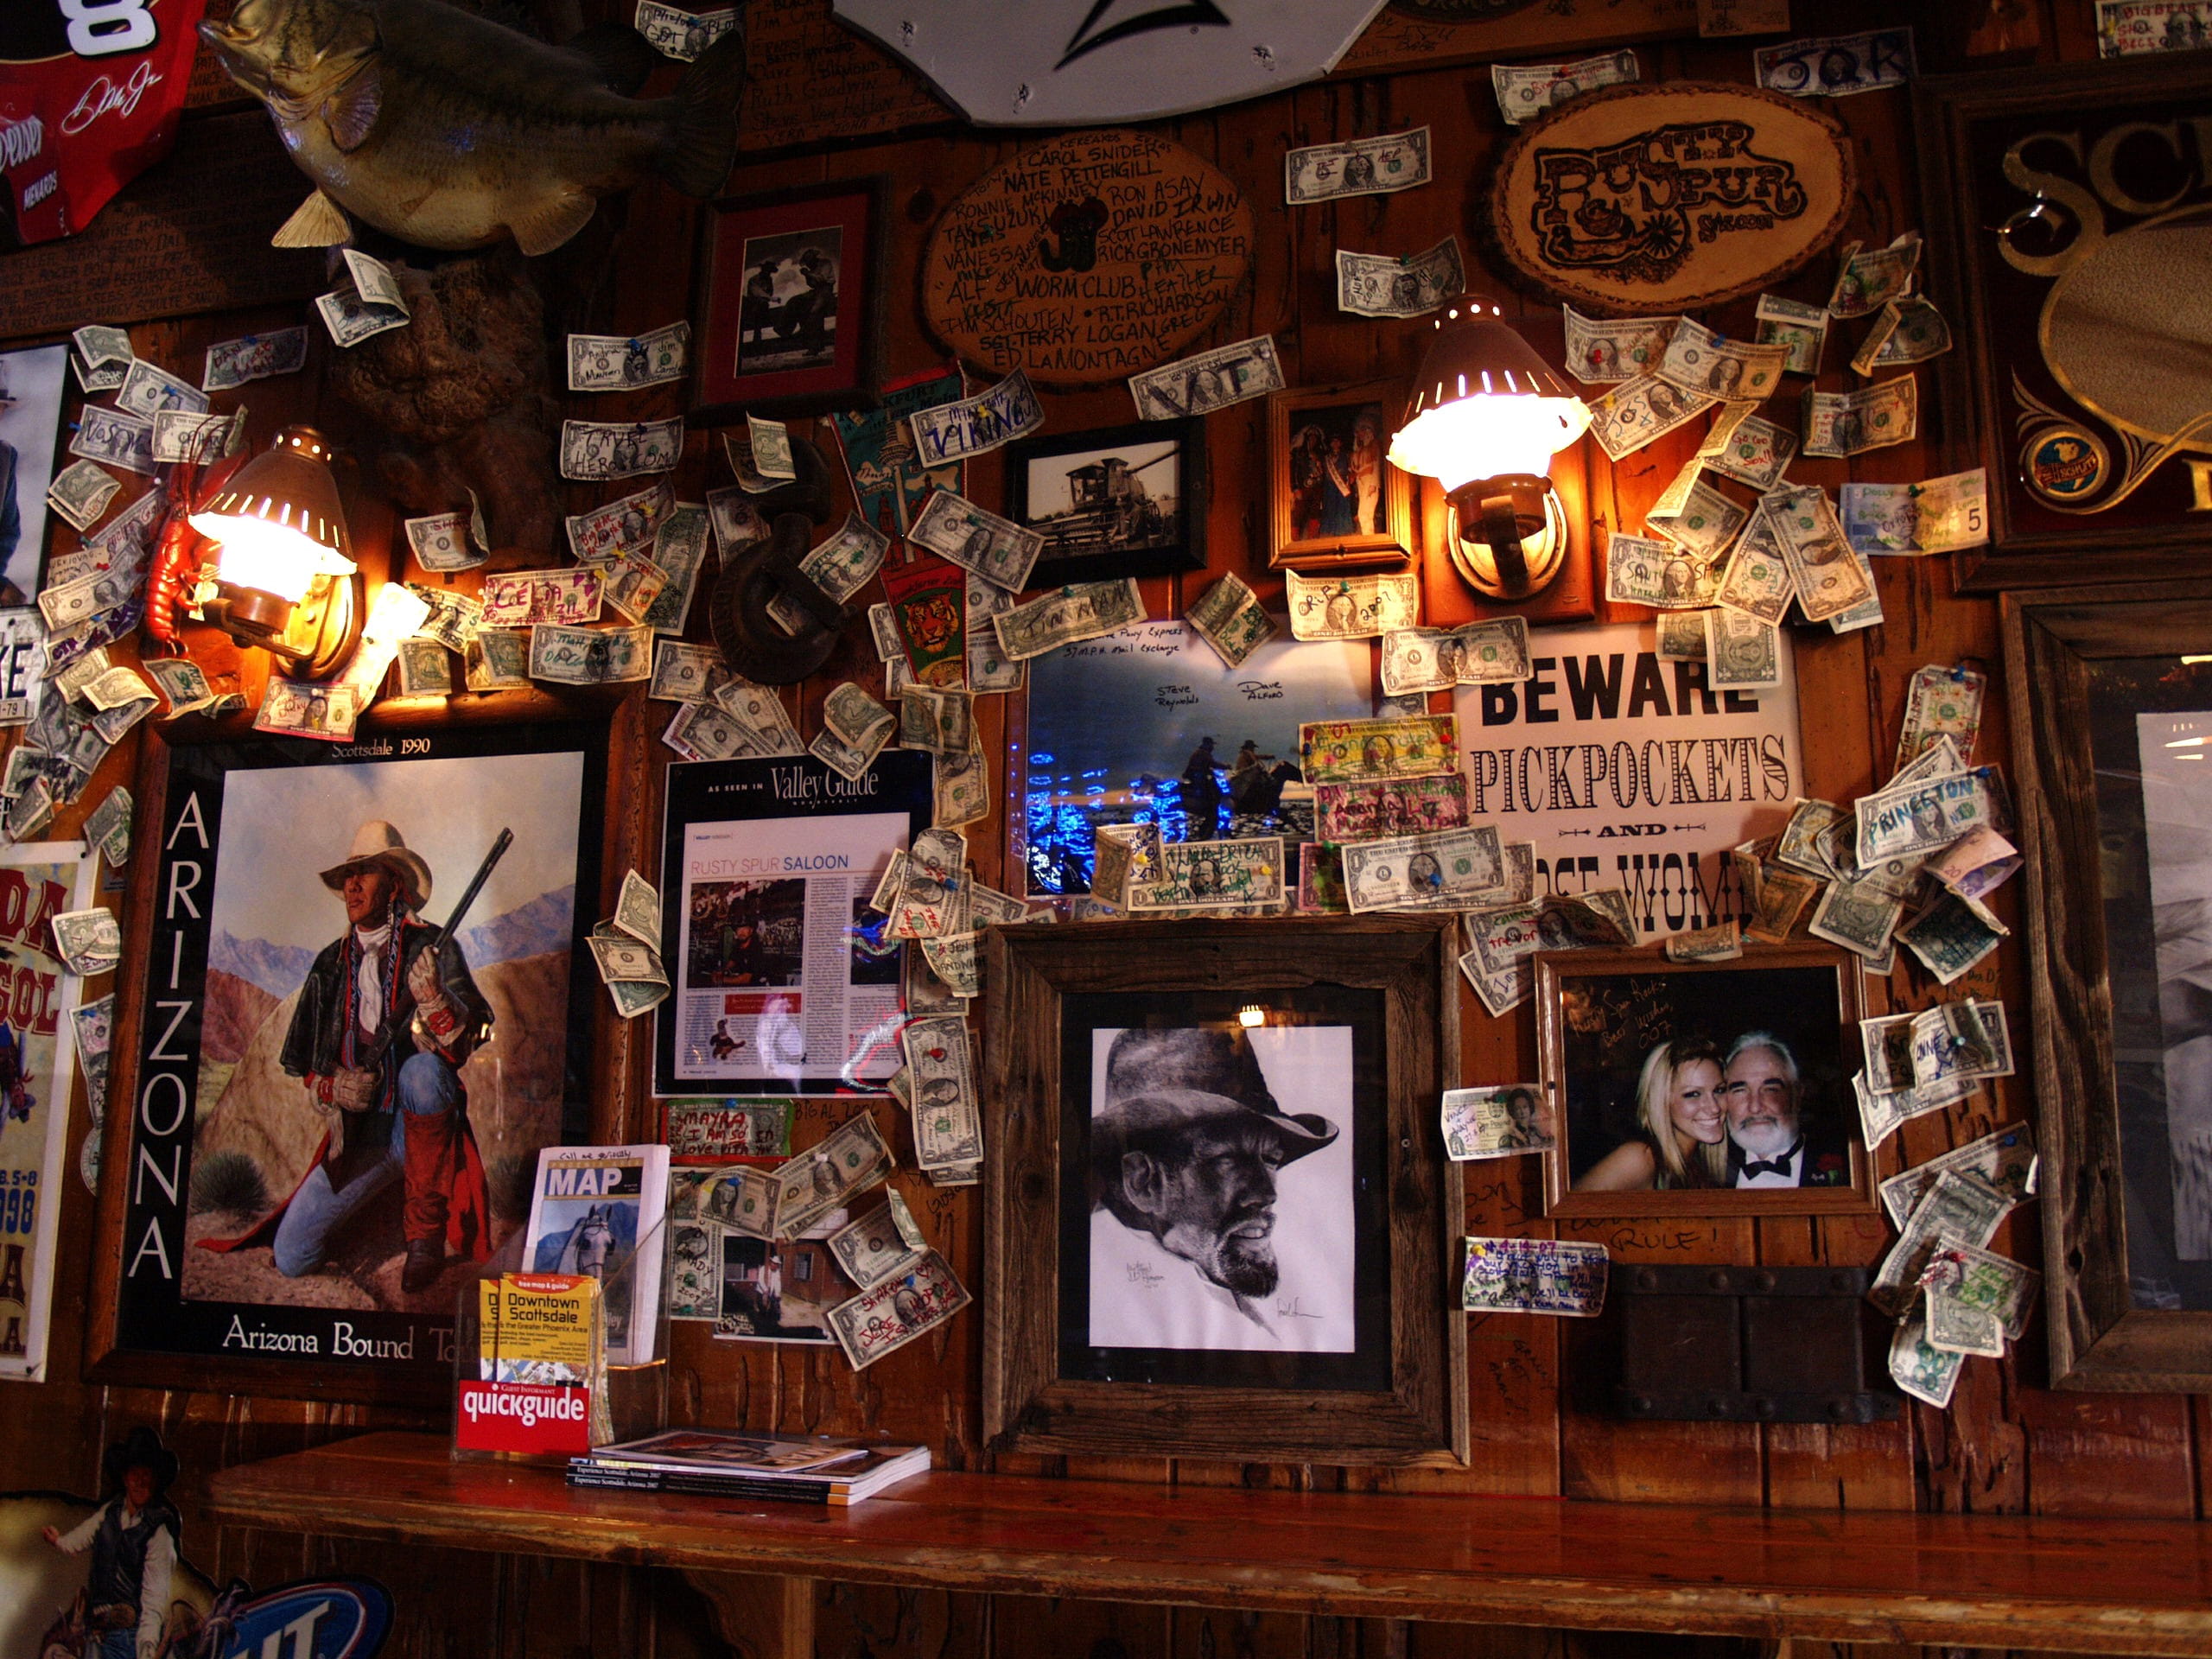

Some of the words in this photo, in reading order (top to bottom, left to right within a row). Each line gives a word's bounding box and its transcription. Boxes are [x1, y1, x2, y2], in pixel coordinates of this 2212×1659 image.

[1027, 144, 1080, 168] CAROL
[1088, 142, 1160, 161] SNIDER
[1003, 170, 1052, 194] NATE
[1062, 160, 1163, 187] PETTENGILL
[1107, 184, 1147, 206] RON
[1154, 172, 1205, 200] ASAY
[953, 199, 1014, 219] RONNIE
[1111, 200, 1168, 230] DAVID
[1173, 191, 1241, 218] IRWIN
[1098, 224, 1138, 245] SCOTT
[1140, 213, 1236, 241] LAWRENCE
[943, 245, 1025, 271] VANESSA
[1096, 242, 1136, 263] RICK
[1136, 235, 1247, 258] GRONEMYER
[946, 280, 987, 304] ALF
[1015, 275, 1079, 299] WORM
[1081, 275, 1138, 299] CLUB
[983, 306, 1074, 333] SCHOUTEN
[1160, 310, 1208, 336] GREG
[1015, 326, 1080, 346] TERRY
[1087, 321, 1158, 343] LOGAN
[994, 349, 1023, 367] ED
[1967, 507, 1981, 531] 5
[1360, 590, 1392, 622] 2007
[1148, 626, 1184, 638] Express
[1141, 644, 1179, 656] Exchange
[332, 739, 393, 758] Scottsdale
[400, 736, 431, 755] 1990
[1471, 734, 1789, 814] PICKPOCKETS
[708, 785, 720, 793] AS
[724, 783, 748, 792] SEEN
[753, 782, 764, 791] IN
[771, 766, 823, 809] Valley
[825, 770, 880, 797] Guide
[1869, 778, 1975, 846] PRINCETON
[1597, 823, 1668, 838] AND
[691, 857, 739, 875] RUSTY
[741, 855, 780, 874] SPUR
[783, 854, 849, 871] SALOON
[1944, 865, 1961, 879] 20
[128, 789, 210, 1281] ARIZONA
[1638, 1020, 1673, 1050] 007
[548, 1167, 623, 1196] MAP
[518, 1280, 531, 1288] free
[532, 1281, 545, 1290] map
[551, 1281, 570, 1291] guide
[508, 1293, 580, 1310] Downtown
[510, 1306, 578, 1324] Scottsdale
[518, 1322, 542, 1332] Greater
[543, 1323, 570, 1333] Phoenix
[571, 1325, 588, 1334] Area
[222, 1313, 320, 1355] Arizona
[331, 1320, 414, 1361] Bound
[500, 1383, 520, 1393] GUEST
[521, 1385, 556, 1395] INFORMANT
[463, 1387, 585, 1427] quickguide
